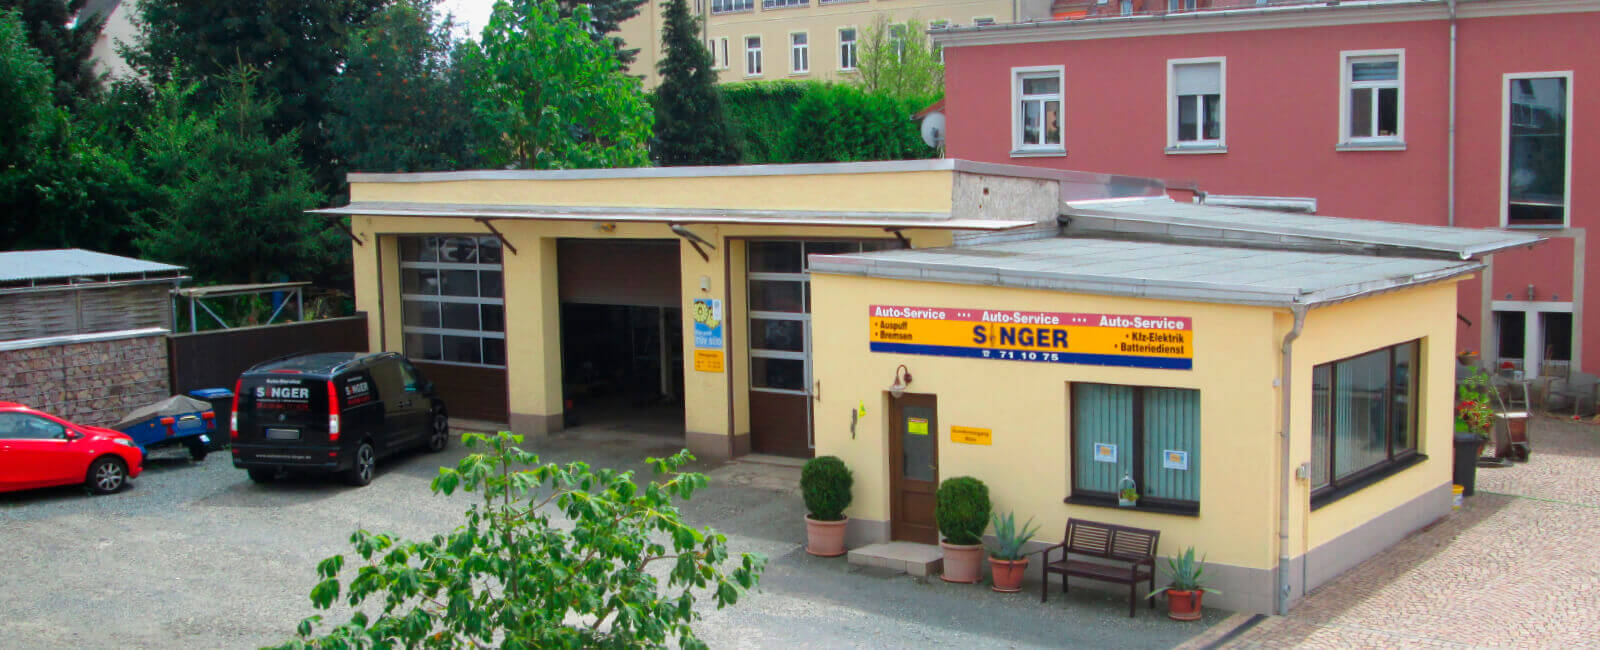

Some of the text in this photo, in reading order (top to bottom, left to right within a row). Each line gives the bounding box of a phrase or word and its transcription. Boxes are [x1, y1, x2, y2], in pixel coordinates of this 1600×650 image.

[875, 306, 1184, 330] Auto-Service Auto-Service Auto-Service
[880, 320, 908, 331] Auspuff
[880, 330, 912, 340] Bremsen
[1131, 332, 1185, 343] Kfz-Elektrik
[1120, 342, 1185, 354] Batteriedienst
[1000, 350, 1059, 361] 71 10 75
